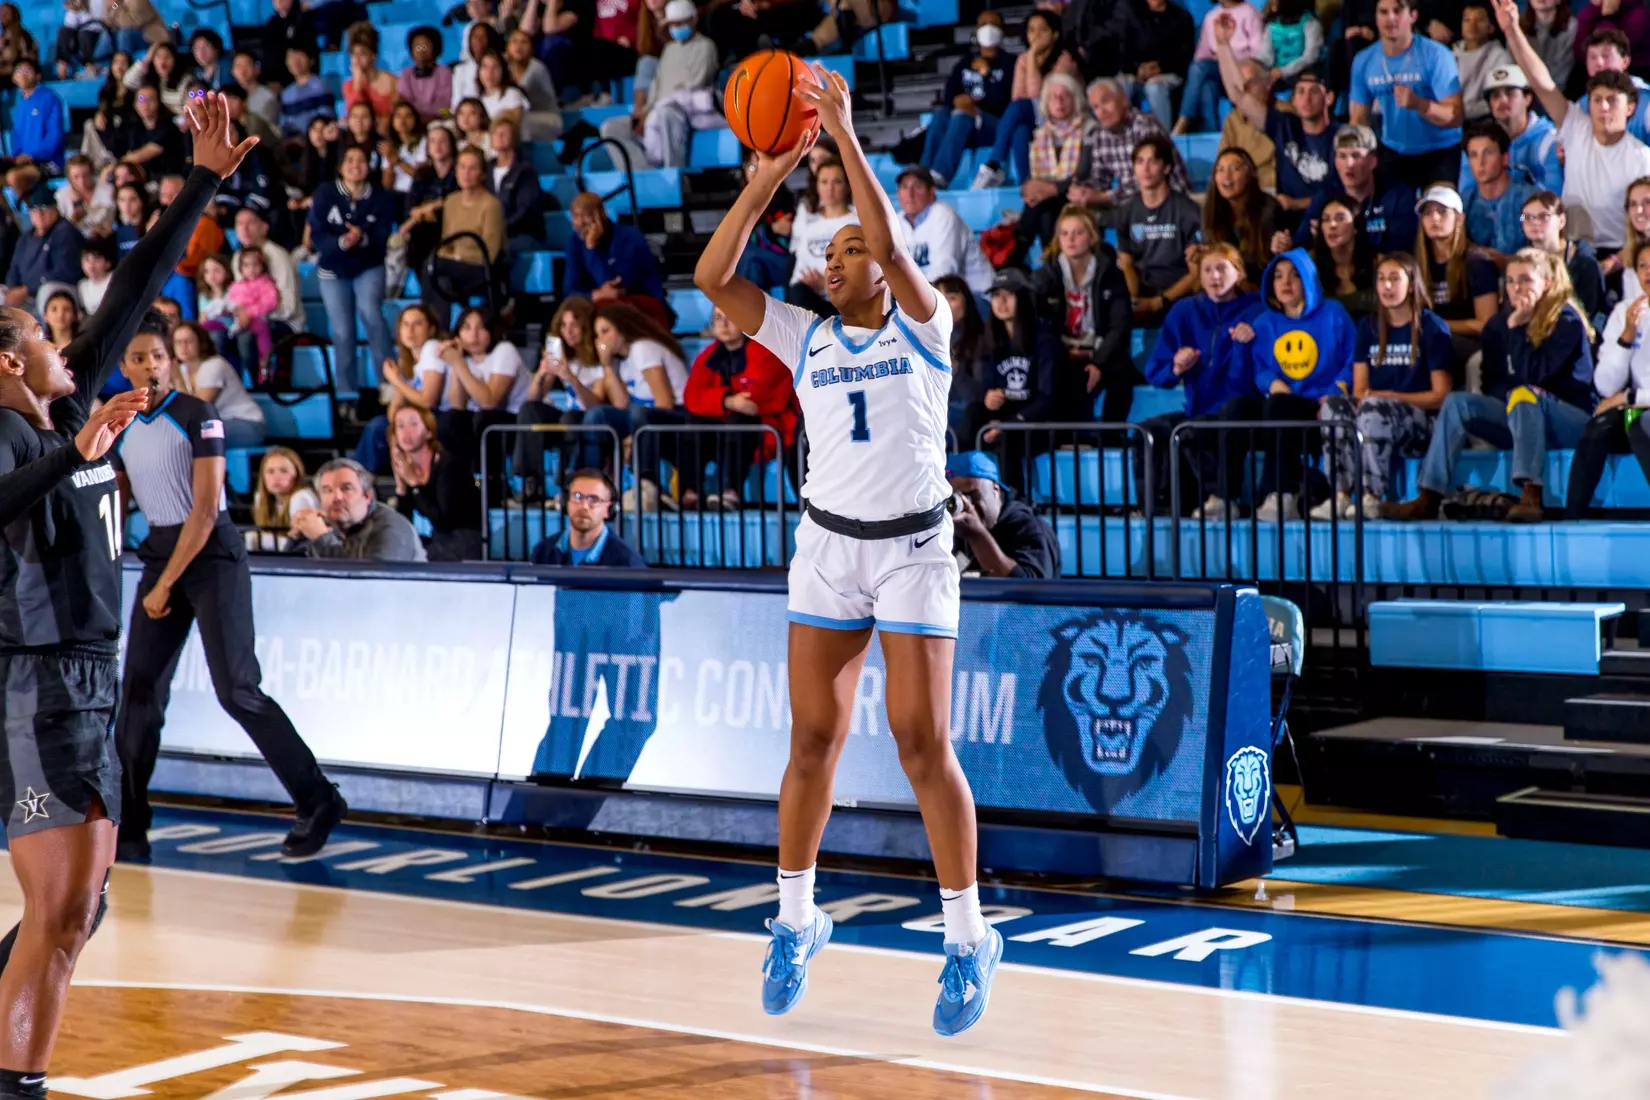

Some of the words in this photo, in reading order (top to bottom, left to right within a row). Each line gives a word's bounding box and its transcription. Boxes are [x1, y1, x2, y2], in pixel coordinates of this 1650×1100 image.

[878, 339, 891, 348] Ivy
[811, 357, 914, 389] COLUMBIA
[846, 389, 871, 443] 1
[694, 658, 1017, 745] CONRUM
[27, 798, 39, 813] V
